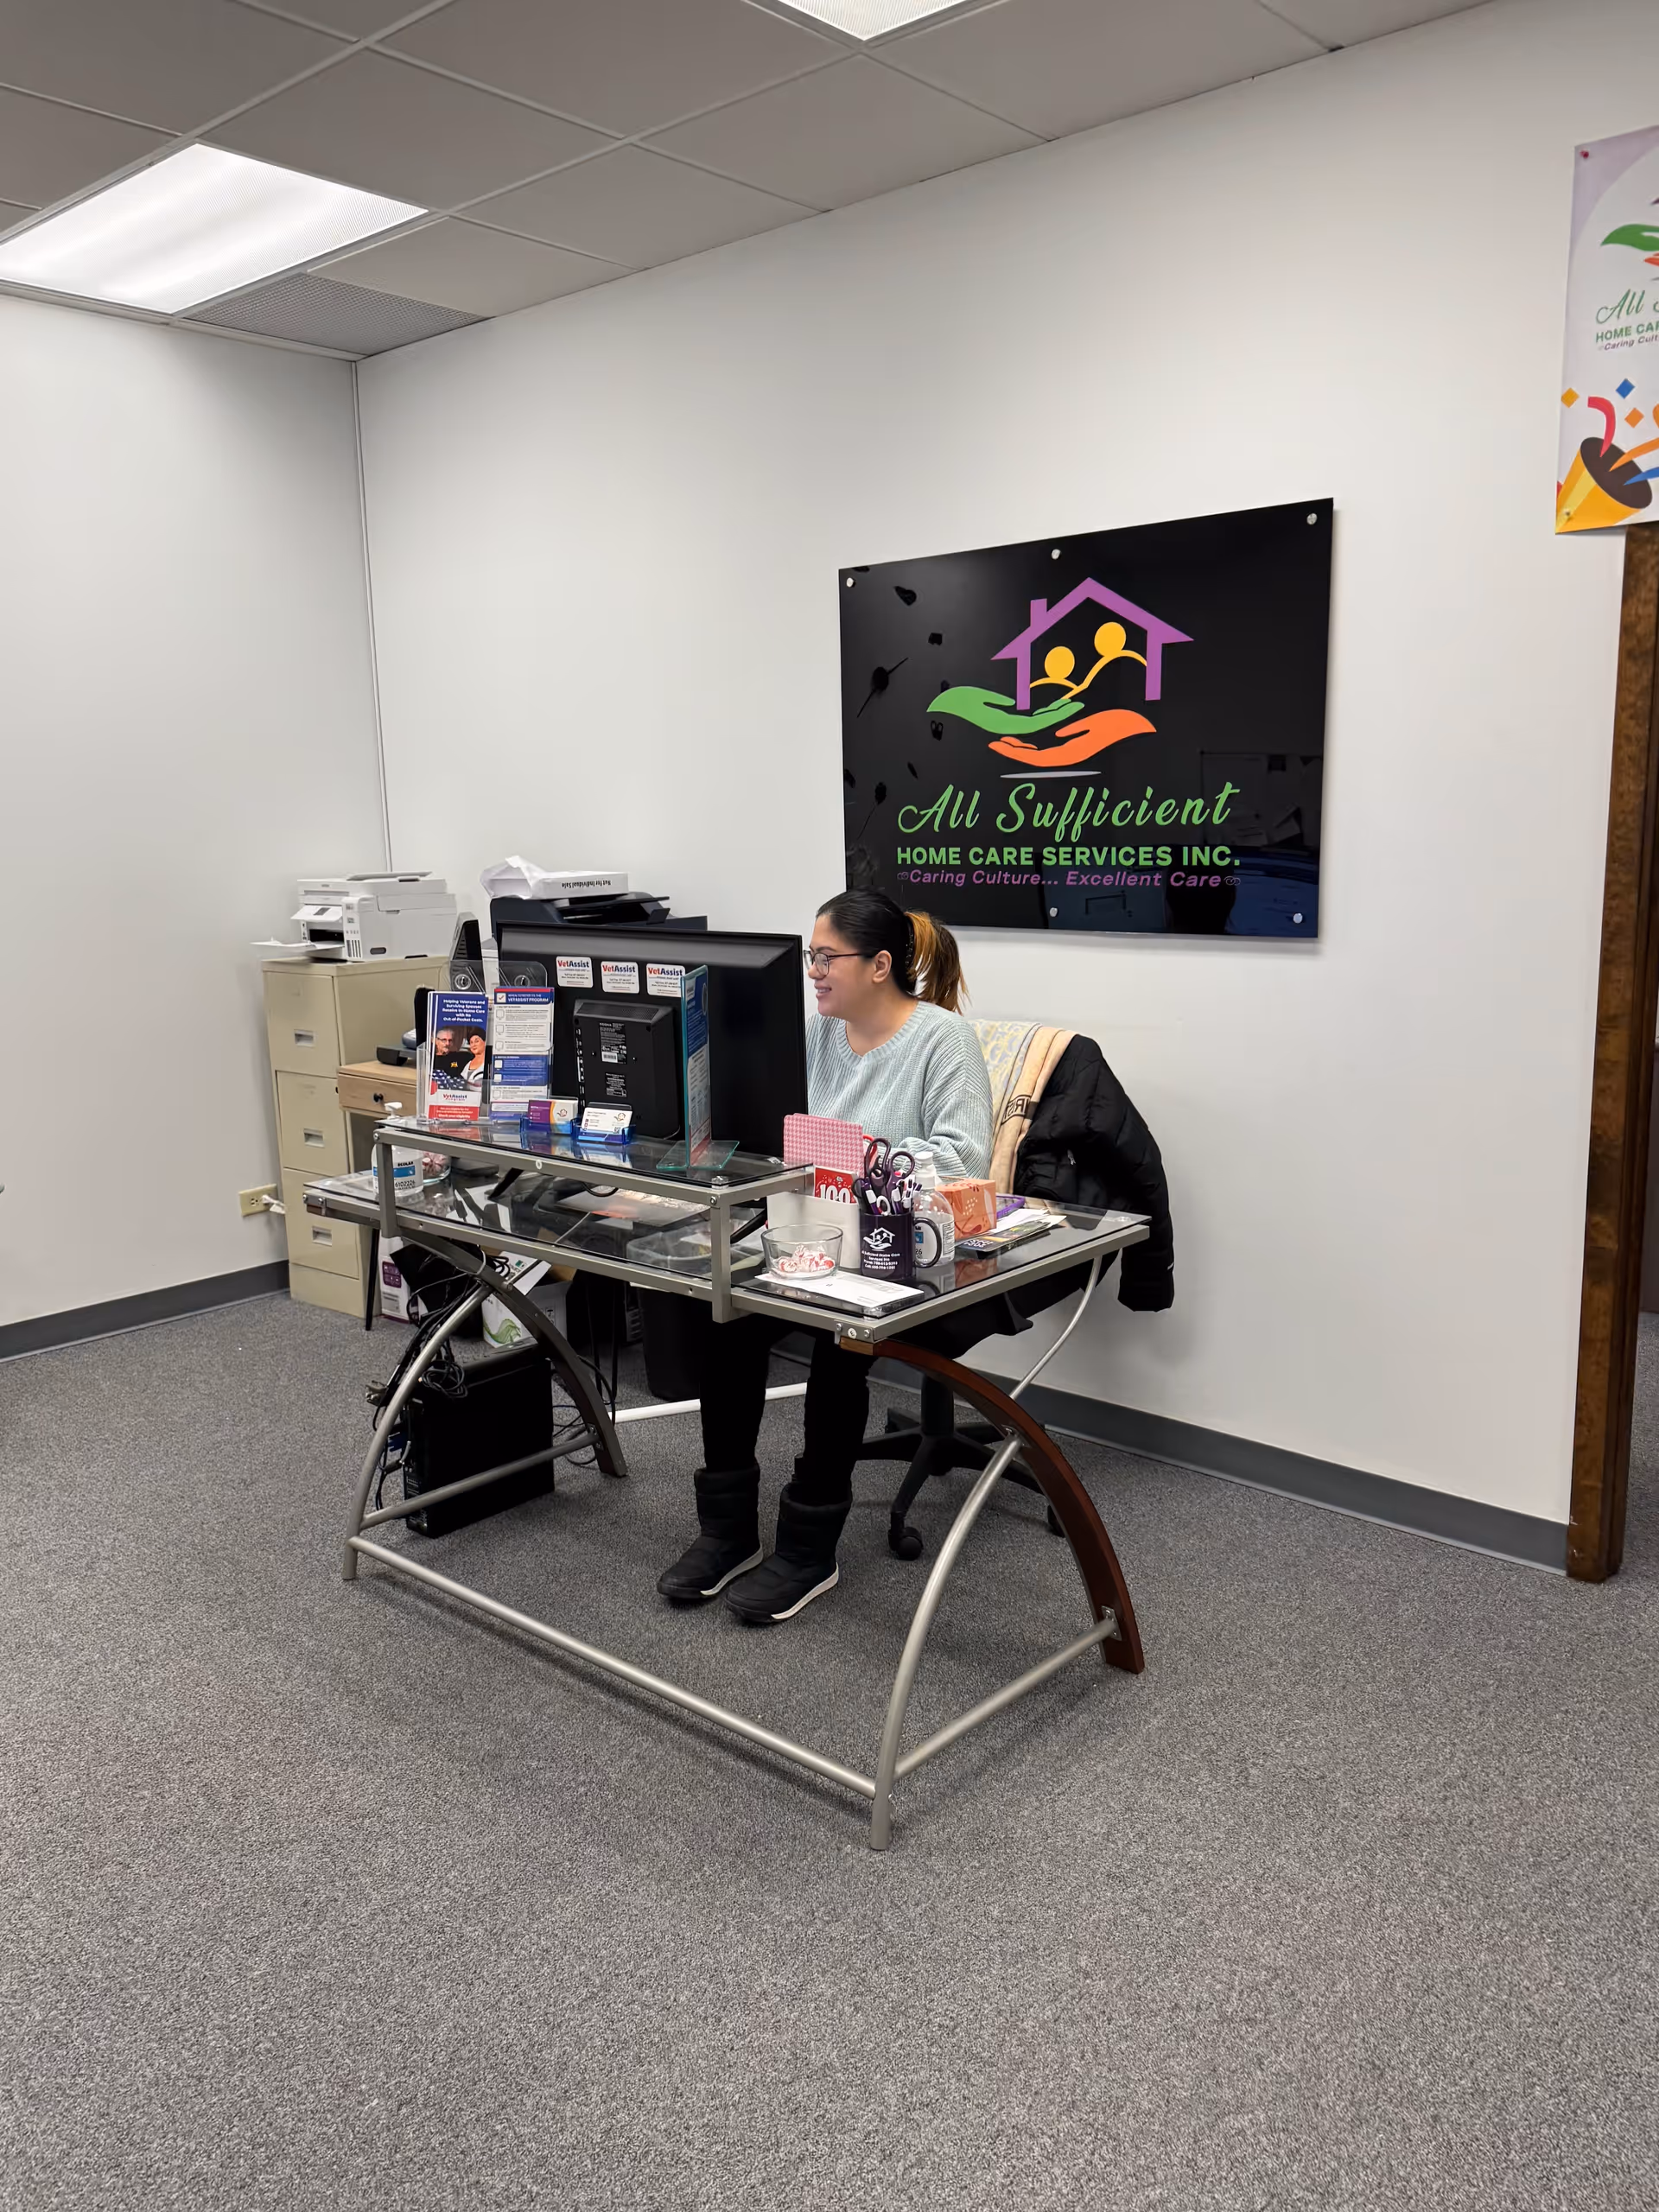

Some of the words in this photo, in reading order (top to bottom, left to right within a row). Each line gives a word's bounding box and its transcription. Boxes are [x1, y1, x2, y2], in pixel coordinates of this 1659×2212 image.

[1596, 289, 1645, 324] All
[1596, 326, 1631, 343] HOME
[1604, 340, 1635, 351] Caring
[1638, 334, 1659, 344] Cult
[898, 784, 981, 833] All
[996, 781, 1241, 842] Sufficient
[897, 847, 961, 865] HOME
[969, 847, 1033, 866] CARE
[1042, 846, 1173, 866] SERVICES
[1182, 846, 1240, 866] INC.
[910, 869, 966, 887] Caring
[972, 870, 1058, 885] Culture...
[1065, 871, 1162, 886] Excellent
[1170, 871, 1222, 887] Care
[648, 968, 683, 976] VetAssist
